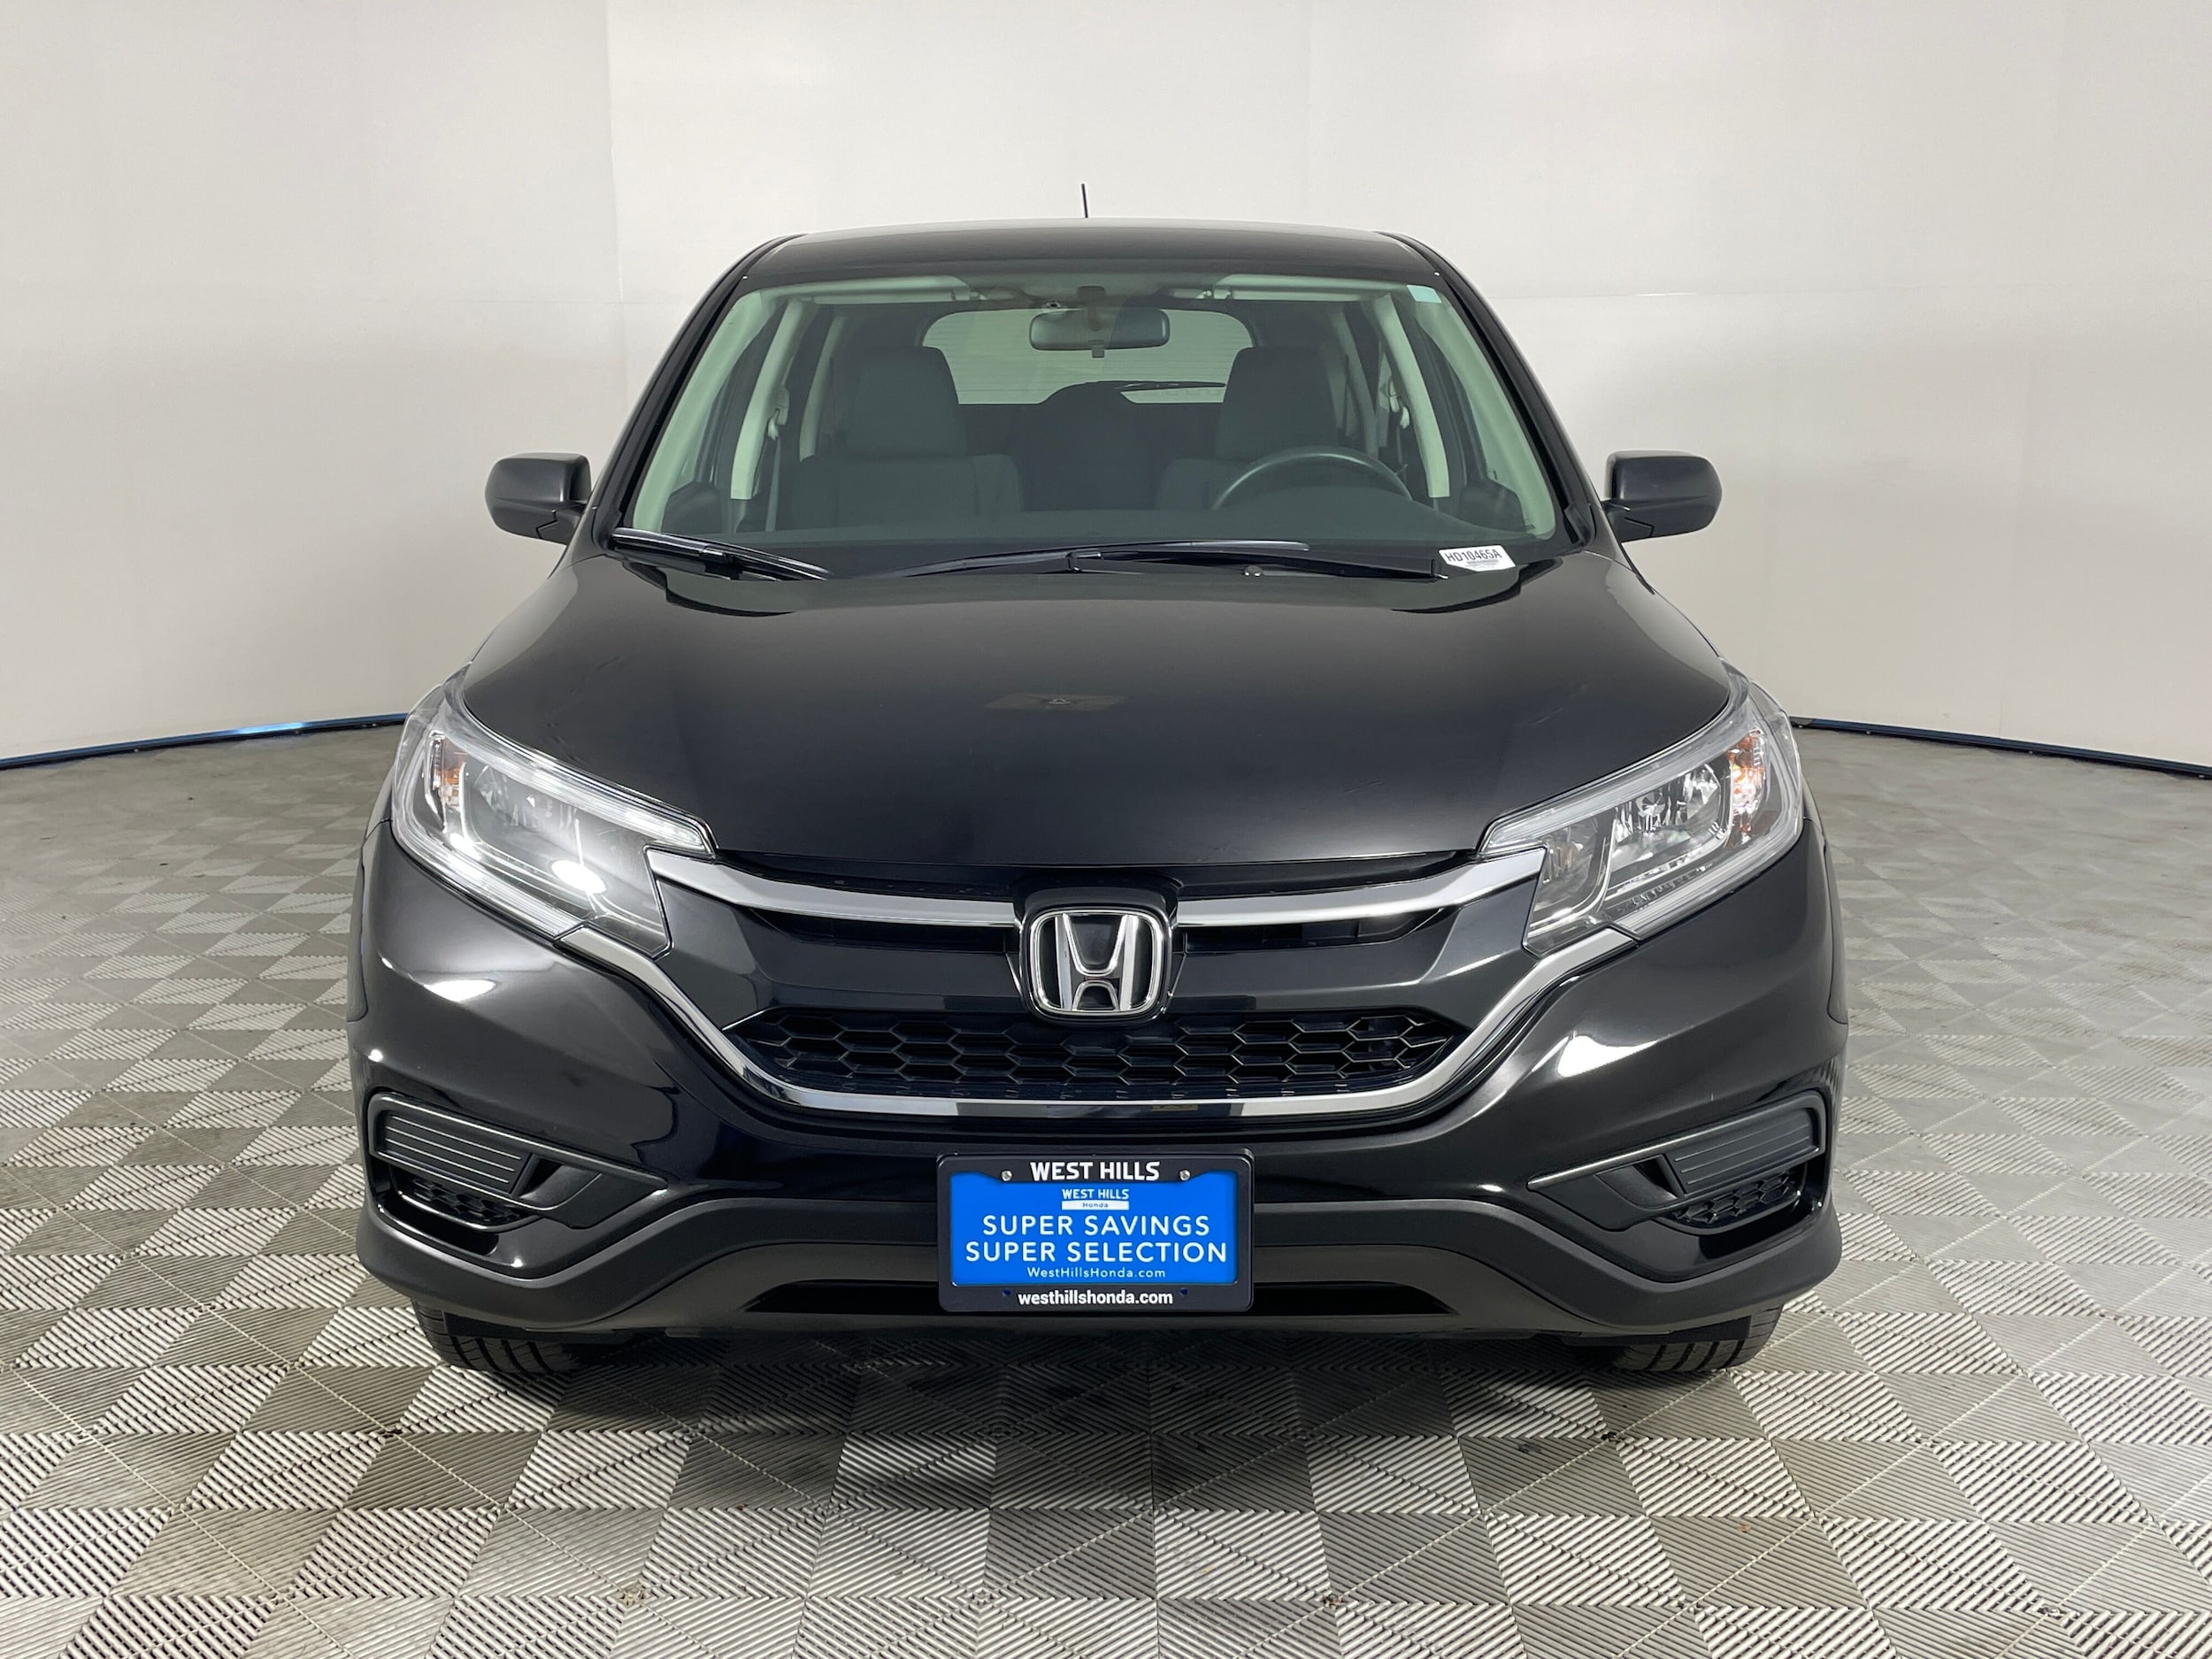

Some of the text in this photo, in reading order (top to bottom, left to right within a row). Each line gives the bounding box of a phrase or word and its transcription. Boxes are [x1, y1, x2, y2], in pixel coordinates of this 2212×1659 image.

[1444, 549, 1502, 563] HD10465A
[1030, 1161, 1161, 1181] WEST HILLS
[1062, 1188, 1130, 1200] WEST HILLS
[982, 1215, 1210, 1236] SUPER SAVINGS
[965, 1241, 1227, 1263] SUPER SELECTION
[1027, 1267, 1166, 1279] WestHillsHonda.com
[1018, 1289, 1173, 1305] westhillshonda.com
